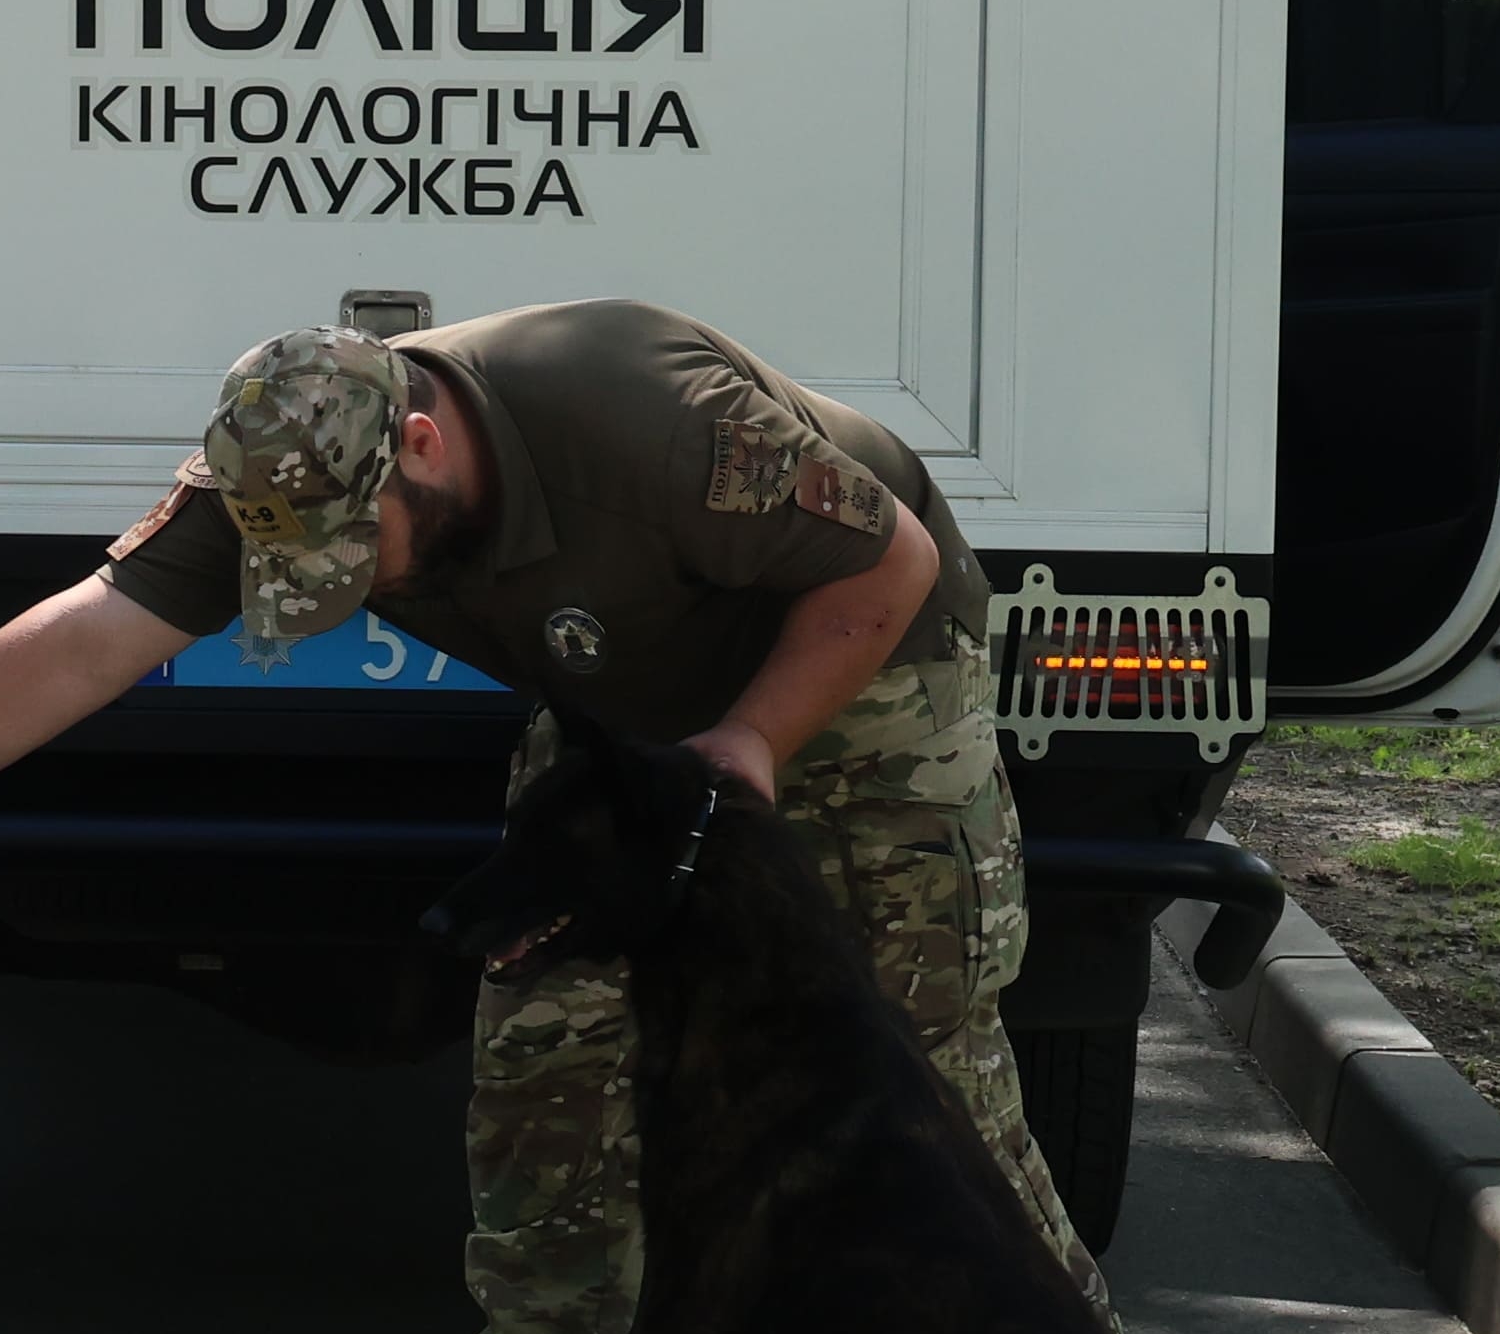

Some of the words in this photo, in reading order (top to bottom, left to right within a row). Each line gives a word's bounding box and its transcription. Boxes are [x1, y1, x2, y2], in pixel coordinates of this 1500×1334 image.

[78, 85, 700, 148] КІНОЛОГІЧНА
[190, 157, 584, 217] СЛУЖБА
[236, 506, 275, 523] K-9
